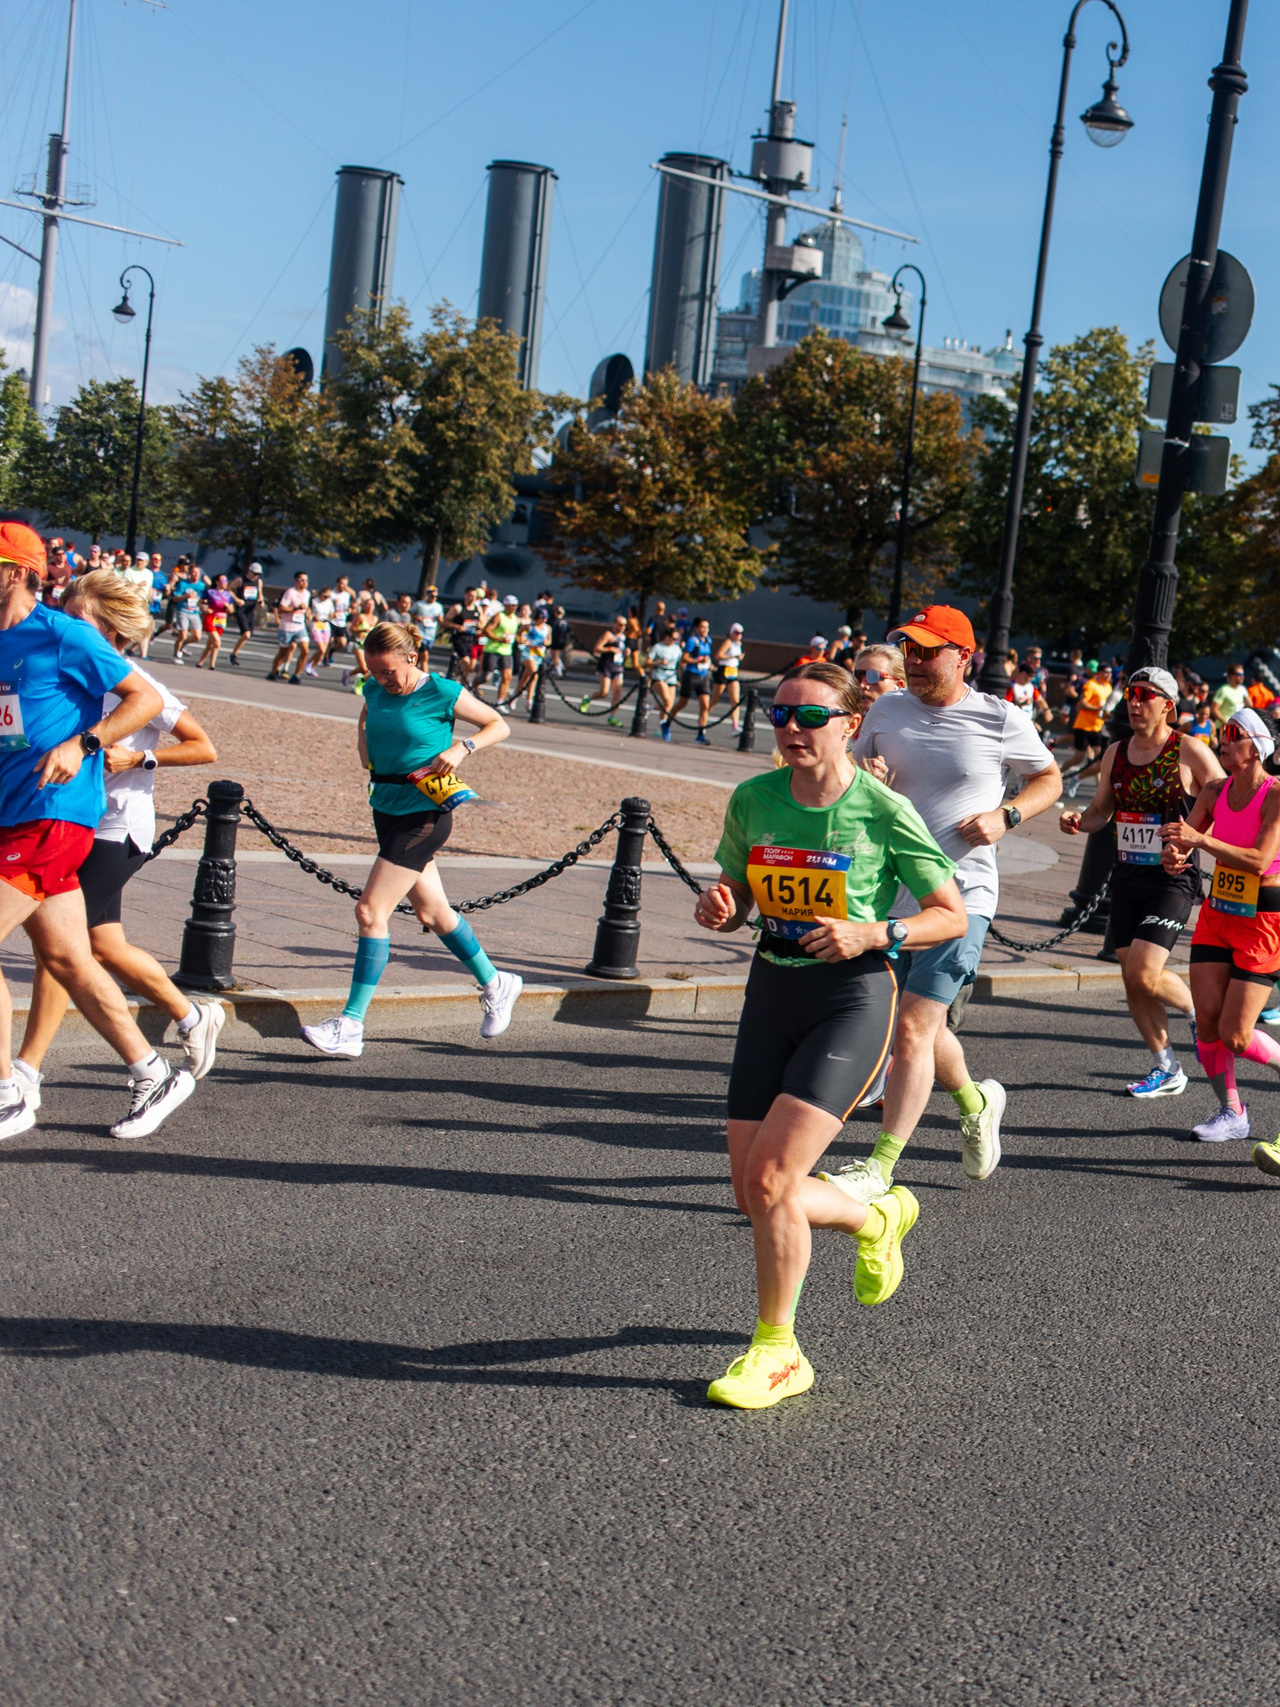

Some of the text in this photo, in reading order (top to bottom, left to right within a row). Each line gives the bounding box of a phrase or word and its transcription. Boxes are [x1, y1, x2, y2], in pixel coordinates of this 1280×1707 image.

[1122, 826, 1155, 844] 4117
[762, 853, 794, 861] МАРАФОН
[805, 855, 821, 863] 21,1
[761, 874, 834, 908] 1514
[1218, 871, 1246, 893] 895
[782, 907, 814, 917] МАРИЯ
